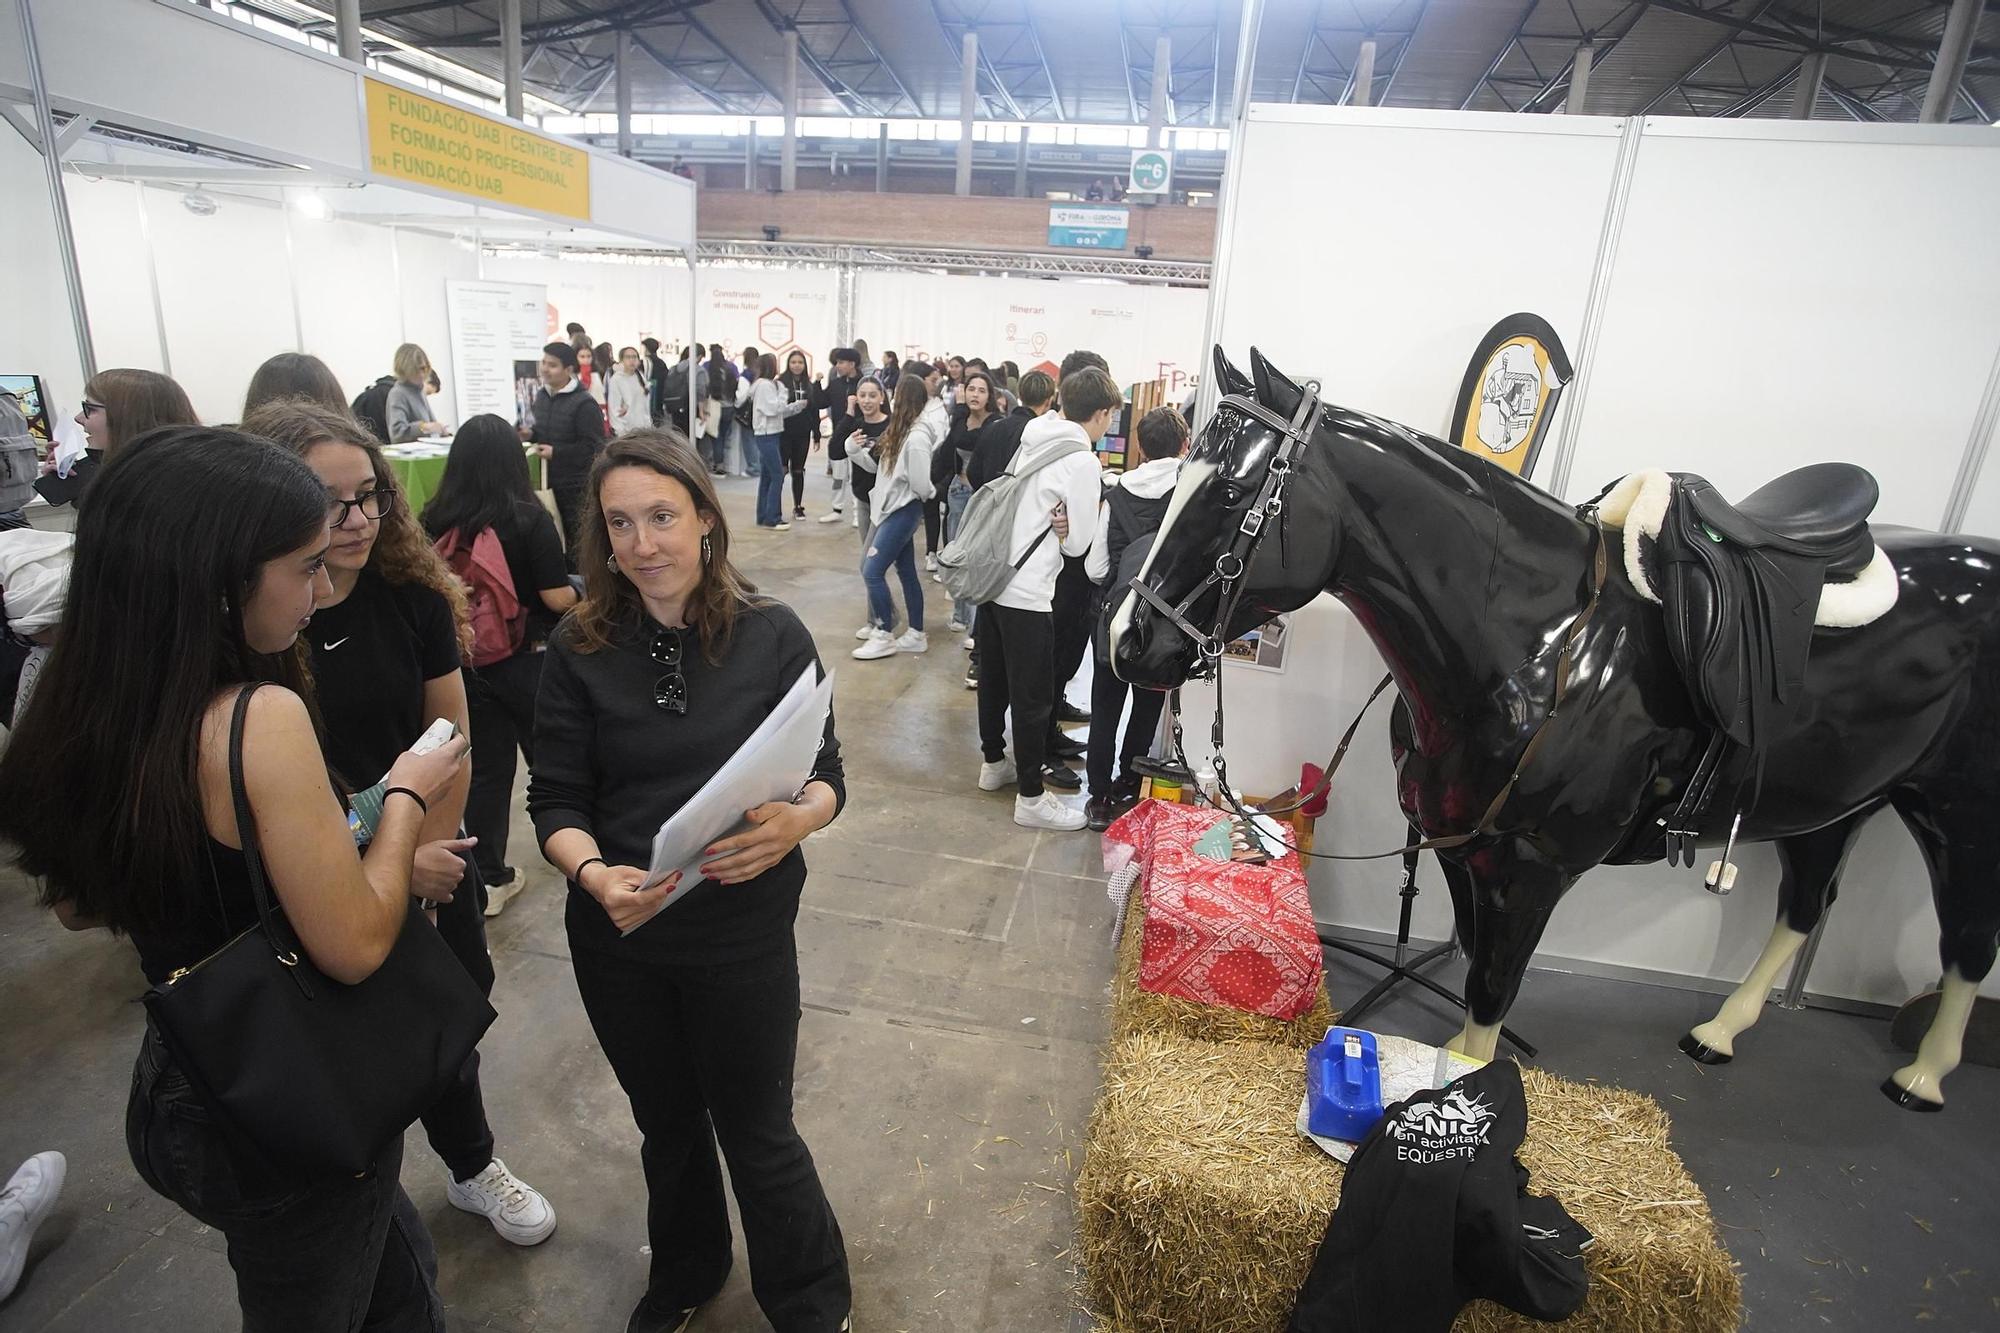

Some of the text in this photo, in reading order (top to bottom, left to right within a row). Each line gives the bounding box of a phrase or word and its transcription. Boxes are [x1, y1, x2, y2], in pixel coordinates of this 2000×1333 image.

[388, 93, 468, 134] FUNDACIÓ
[472, 122, 499, 145] UAB
[511, 134, 557, 163] CENTRE
[559, 150, 575, 169] DE
[390, 122, 567, 189] FORMACIÓ PROFESSIONAL
[393, 151, 503, 195] FUNDACIÓ UAB
[1152, 163, 1163, 179] 6
[713, 288, 761, 299] Construeixo
[1009, 303, 1046, 315] Itinerari
[1158, 361, 1199, 392] FP.g
[1396, 1130, 1482, 1149] en activitat
